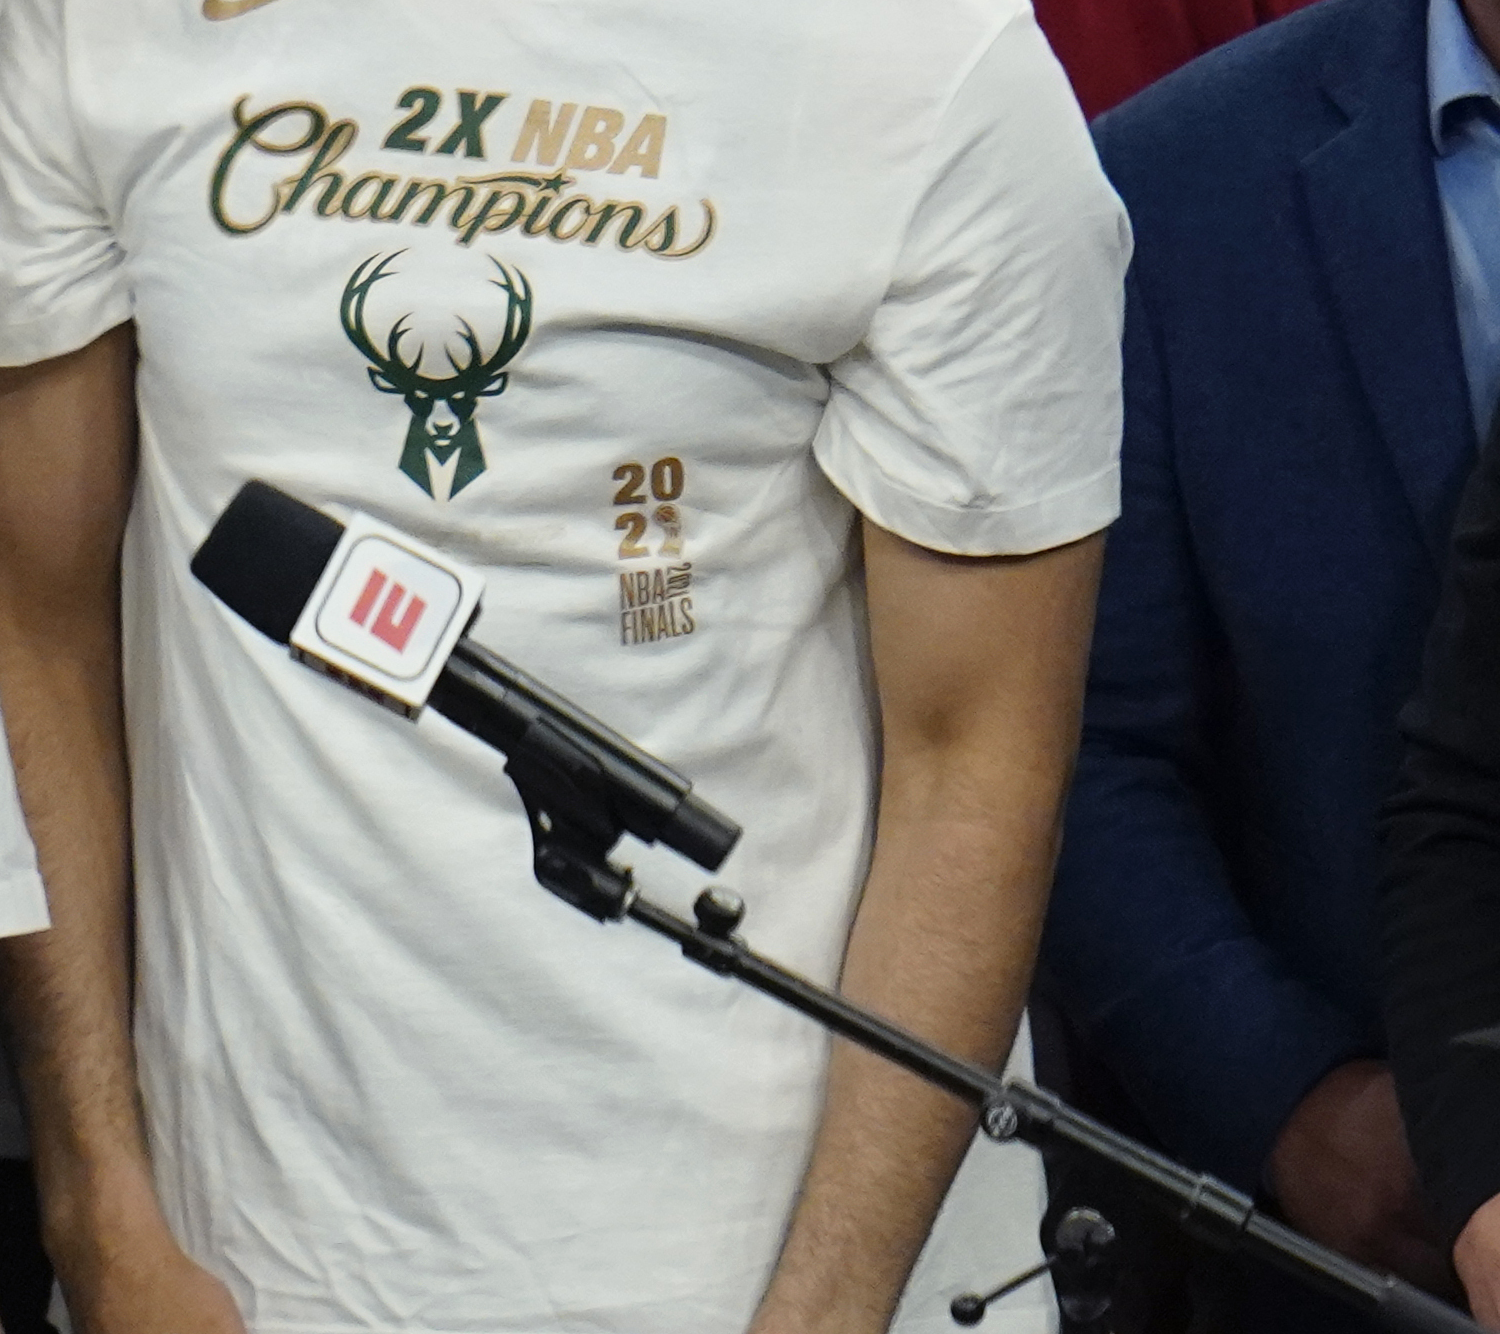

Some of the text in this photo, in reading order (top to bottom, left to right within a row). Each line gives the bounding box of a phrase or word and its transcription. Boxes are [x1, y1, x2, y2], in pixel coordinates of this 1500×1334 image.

[381, 84, 669, 180] 2X NBA
[209, 93, 717, 260] Champions
[612, 456, 685, 505] 20
[620, 568, 666, 610] NBA
[620, 597, 696, 646] FINALS
